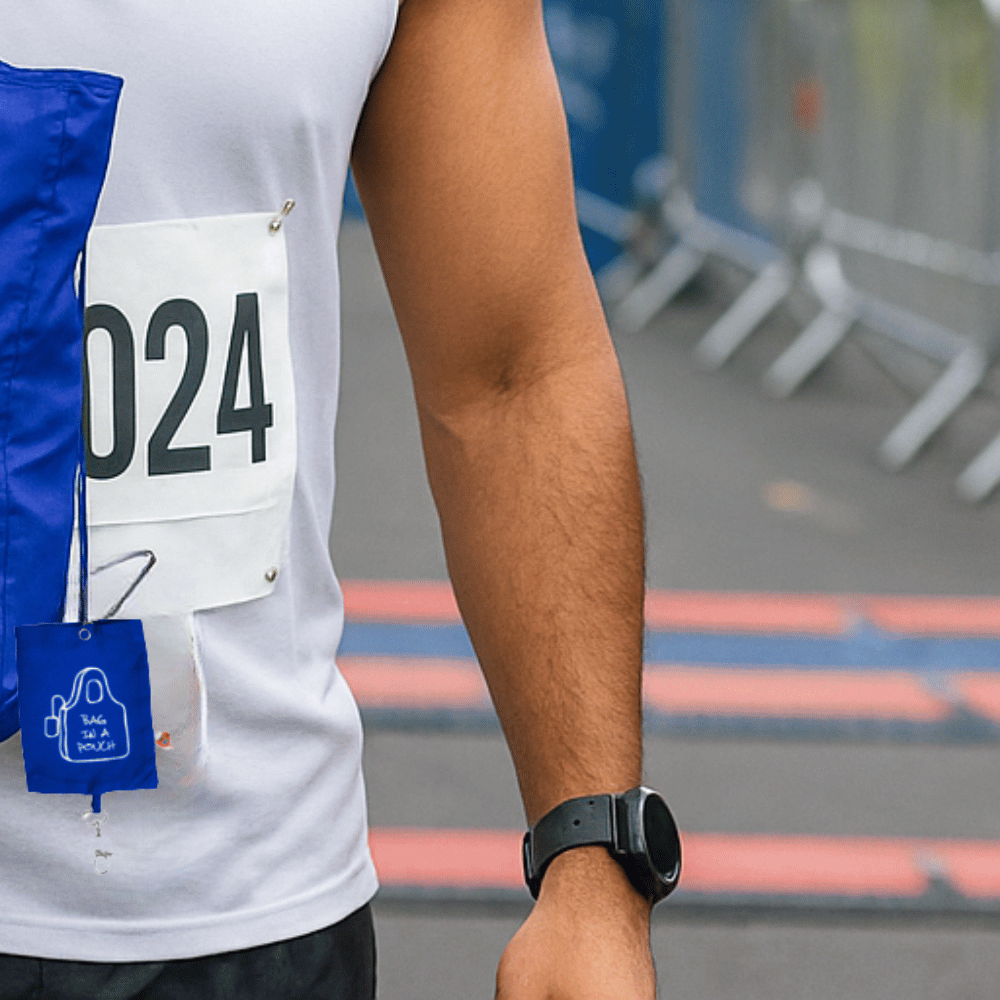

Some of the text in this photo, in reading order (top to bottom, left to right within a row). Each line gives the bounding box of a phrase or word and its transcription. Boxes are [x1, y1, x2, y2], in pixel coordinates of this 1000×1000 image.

[82, 292, 273, 480] 024
[79, 713, 107, 726] BAG
[80, 727, 111, 739] IN A
[76, 740, 116, 753] POUCH
